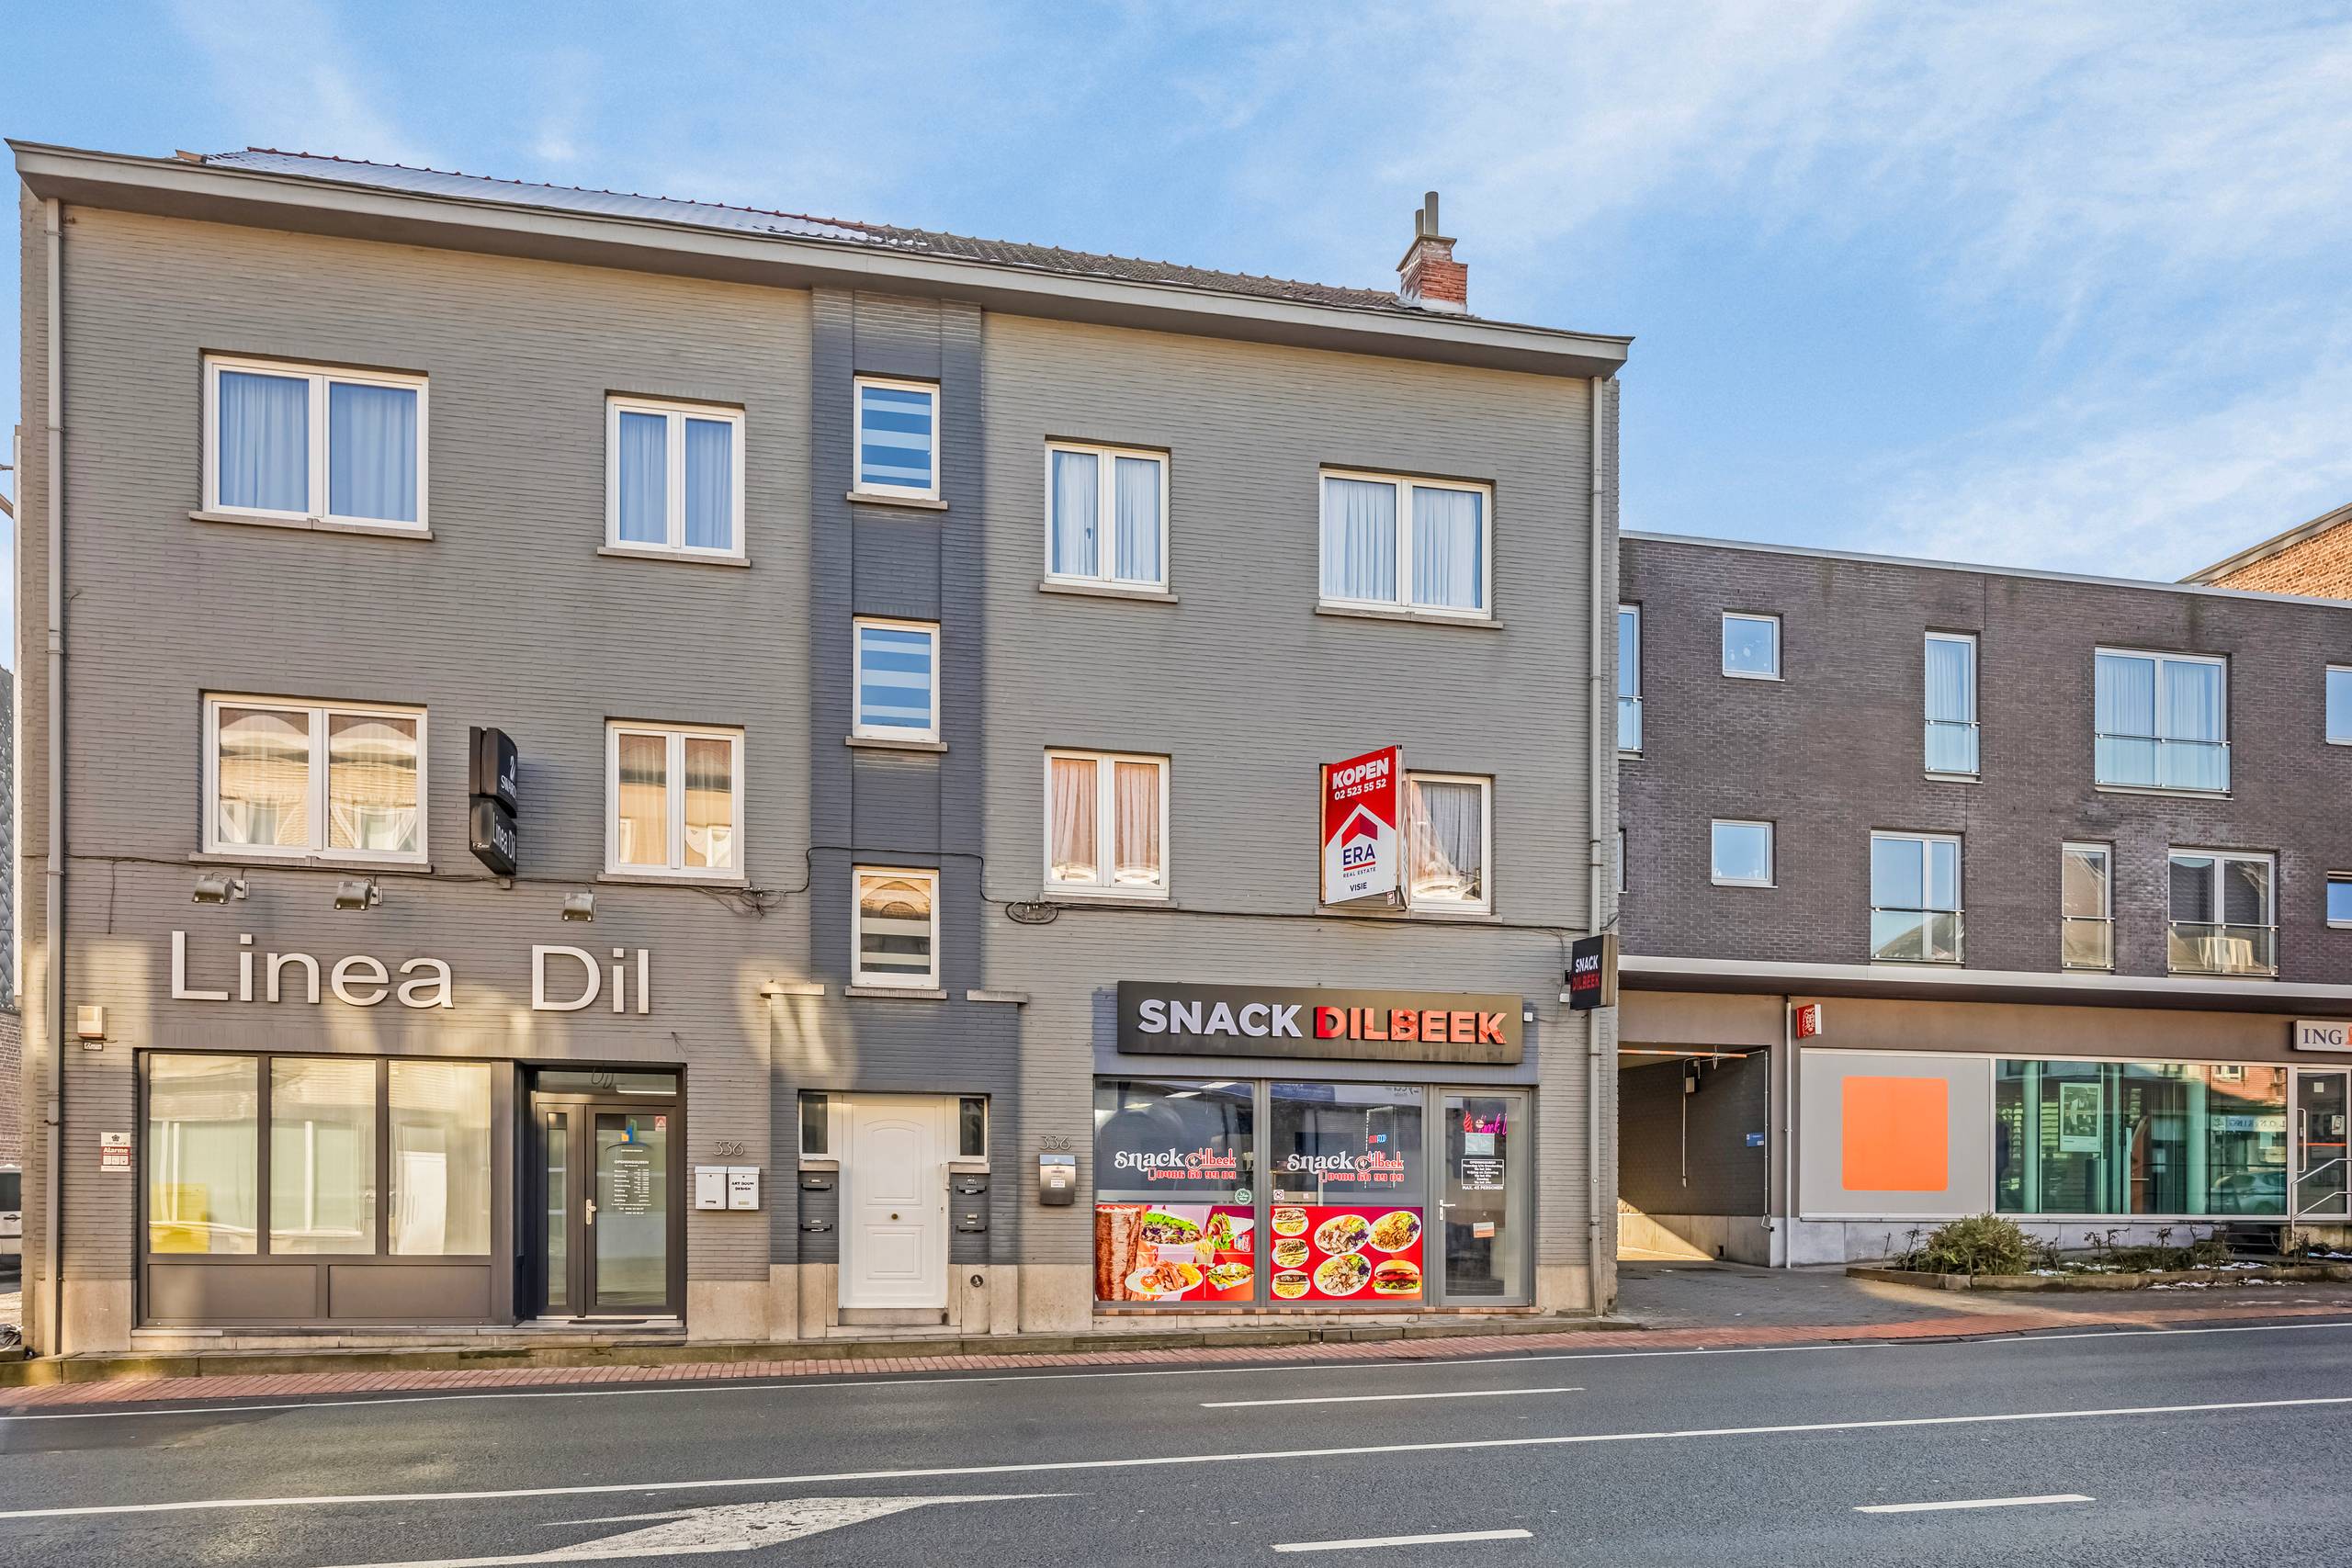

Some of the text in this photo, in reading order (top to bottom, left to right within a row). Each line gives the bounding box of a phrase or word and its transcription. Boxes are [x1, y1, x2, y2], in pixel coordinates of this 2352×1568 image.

[1332, 757, 1389, 790] KOPEN
[1334, 778, 1386, 800] 02 523 55 52
[493, 811, 508, 855] Linea
[1343, 843, 1376, 866] ERA
[1343, 866, 1376, 878] REAL ESTATE
[1350, 882, 1368, 892] VISIE
[171, 930, 650, 1014] Linea Dil
[1575, 954, 1599, 974] SNACK
[1572, 974, 1600, 991] DILBEEK
[1137, 998, 1508, 1044] SNACK DILBEEK
[2302, 1028, 2343, 1045] ING
[713, 1140, 744, 1156] 336
[1038, 1134, 1071, 1150] 336
